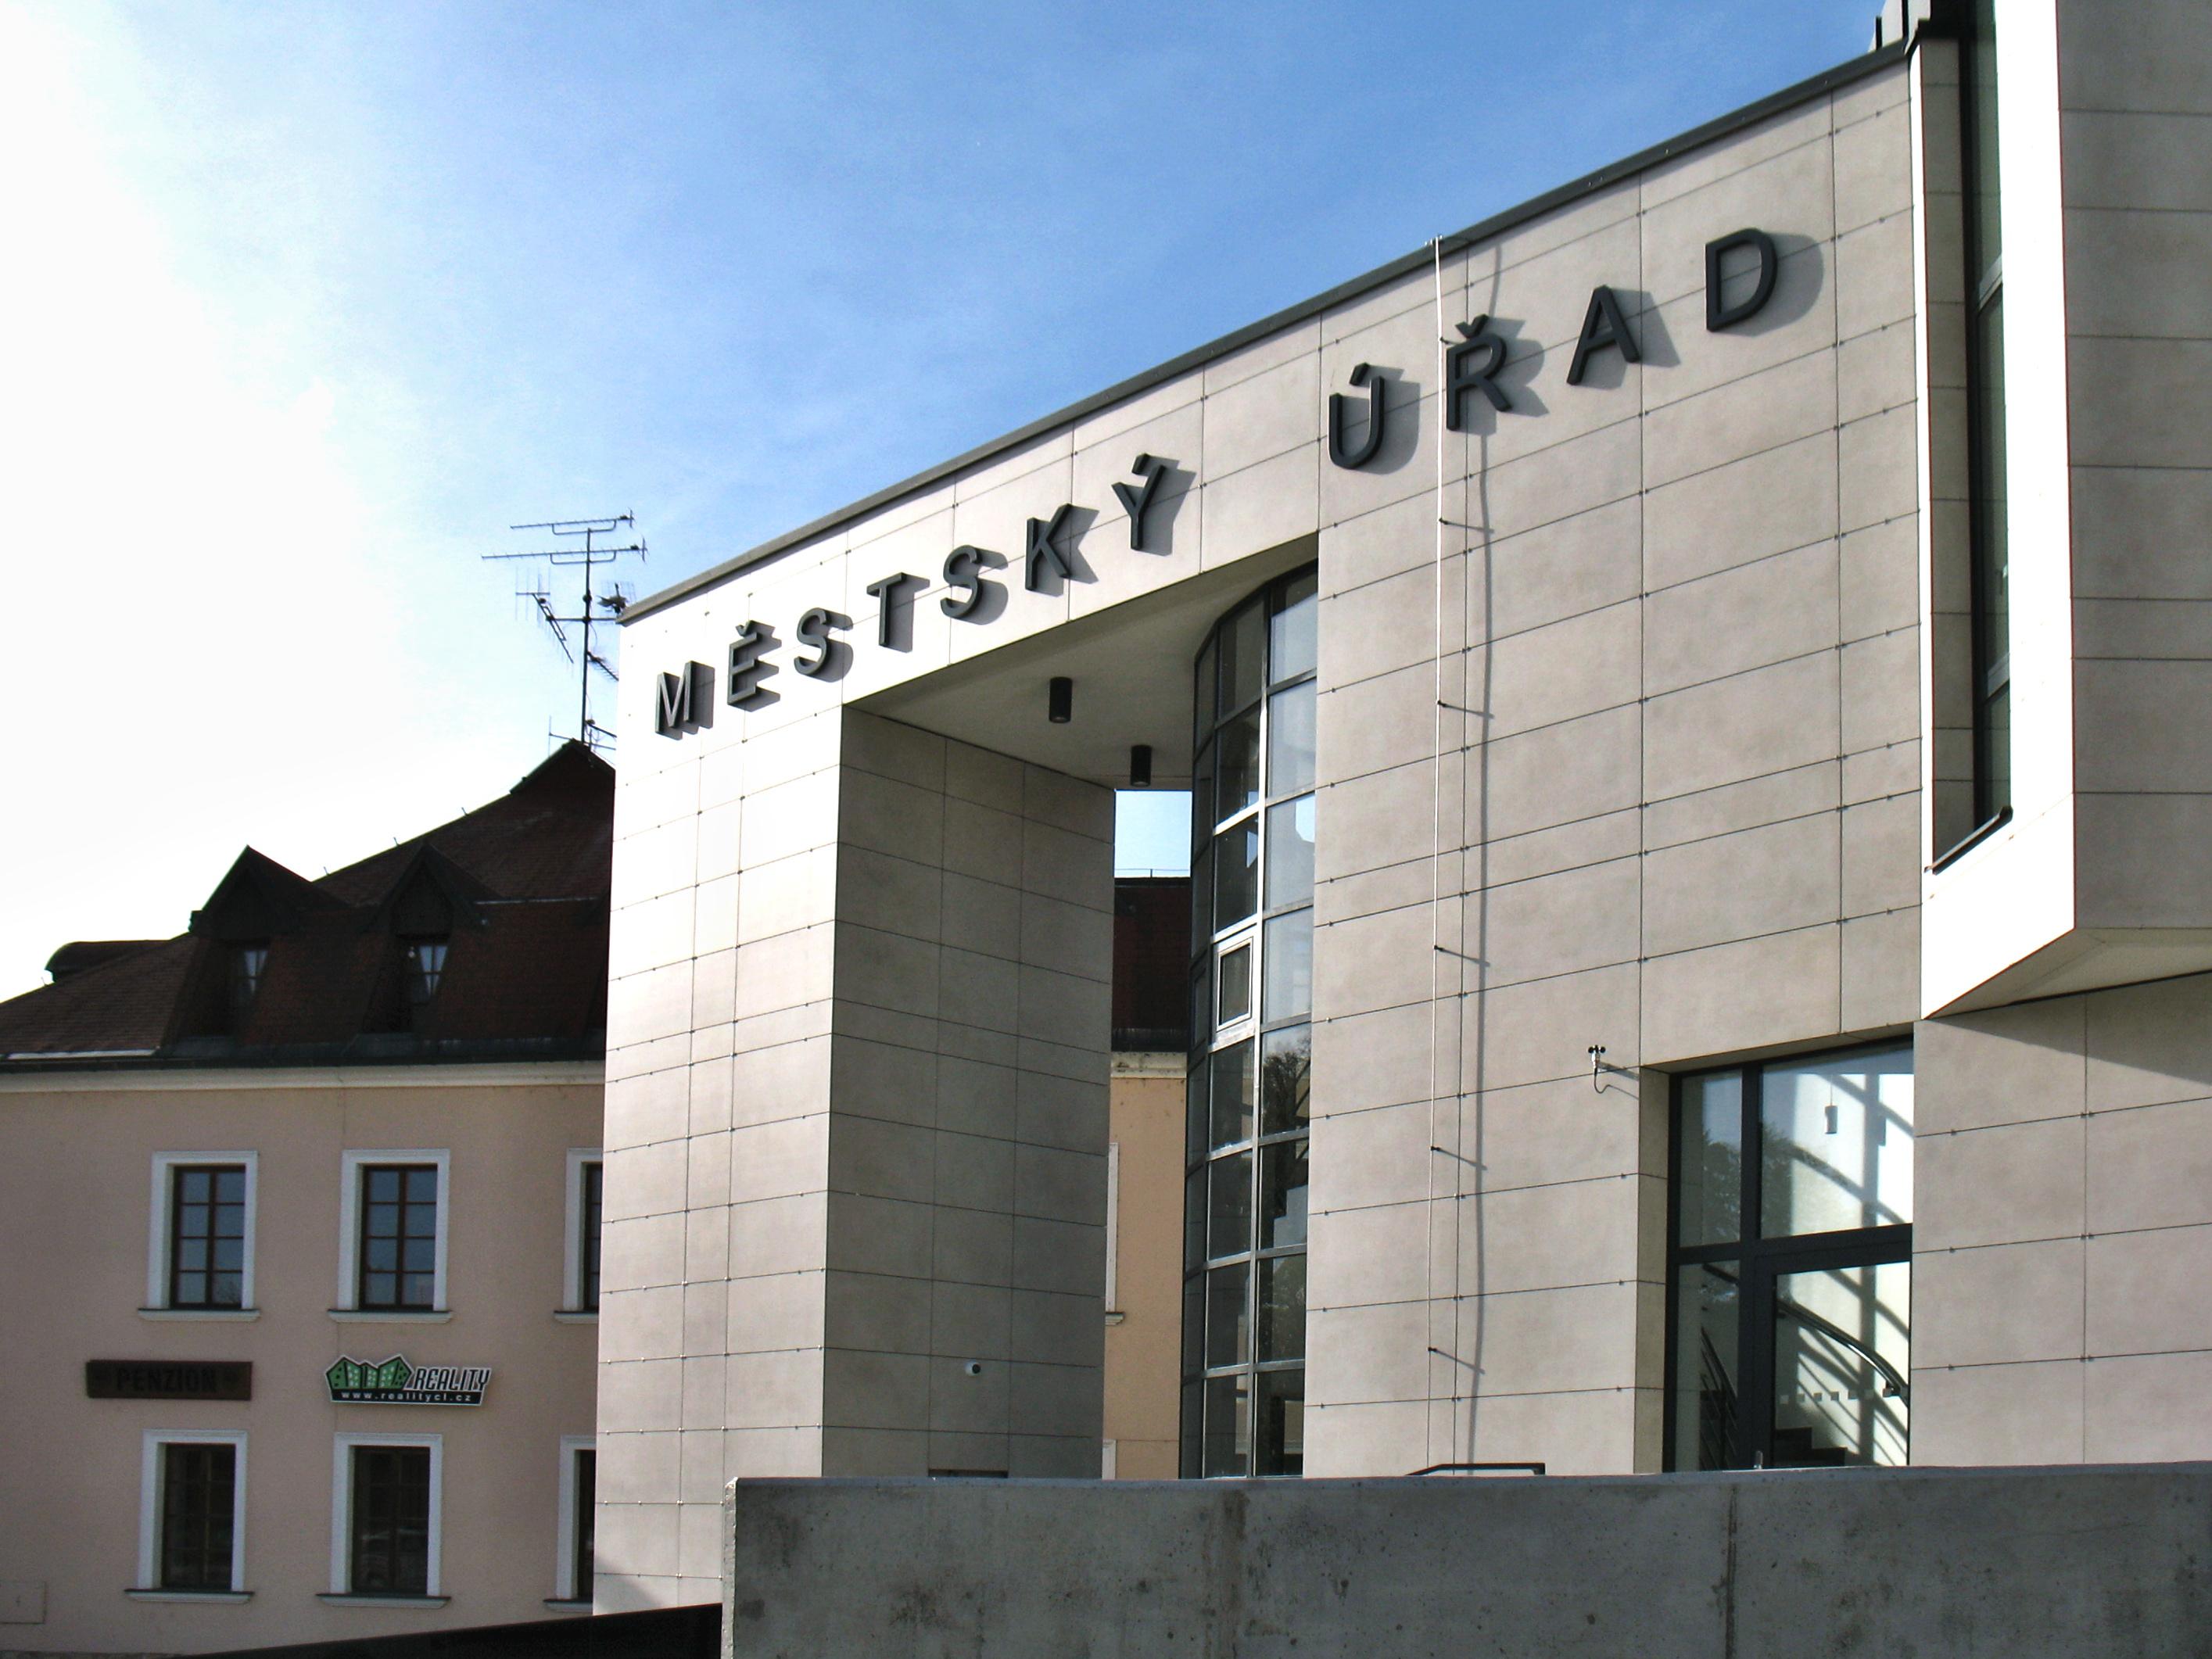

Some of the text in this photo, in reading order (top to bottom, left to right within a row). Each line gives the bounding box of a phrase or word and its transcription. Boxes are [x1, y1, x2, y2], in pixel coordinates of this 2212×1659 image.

[655, 228, 1778, 734] MĚSTSKÝ ÚŘAD
[115, 1367, 217, 1393] PENZION
[414, 1367, 490, 1391] REALITY
[341, 1392, 471, 1403] www.realitycl.cz
